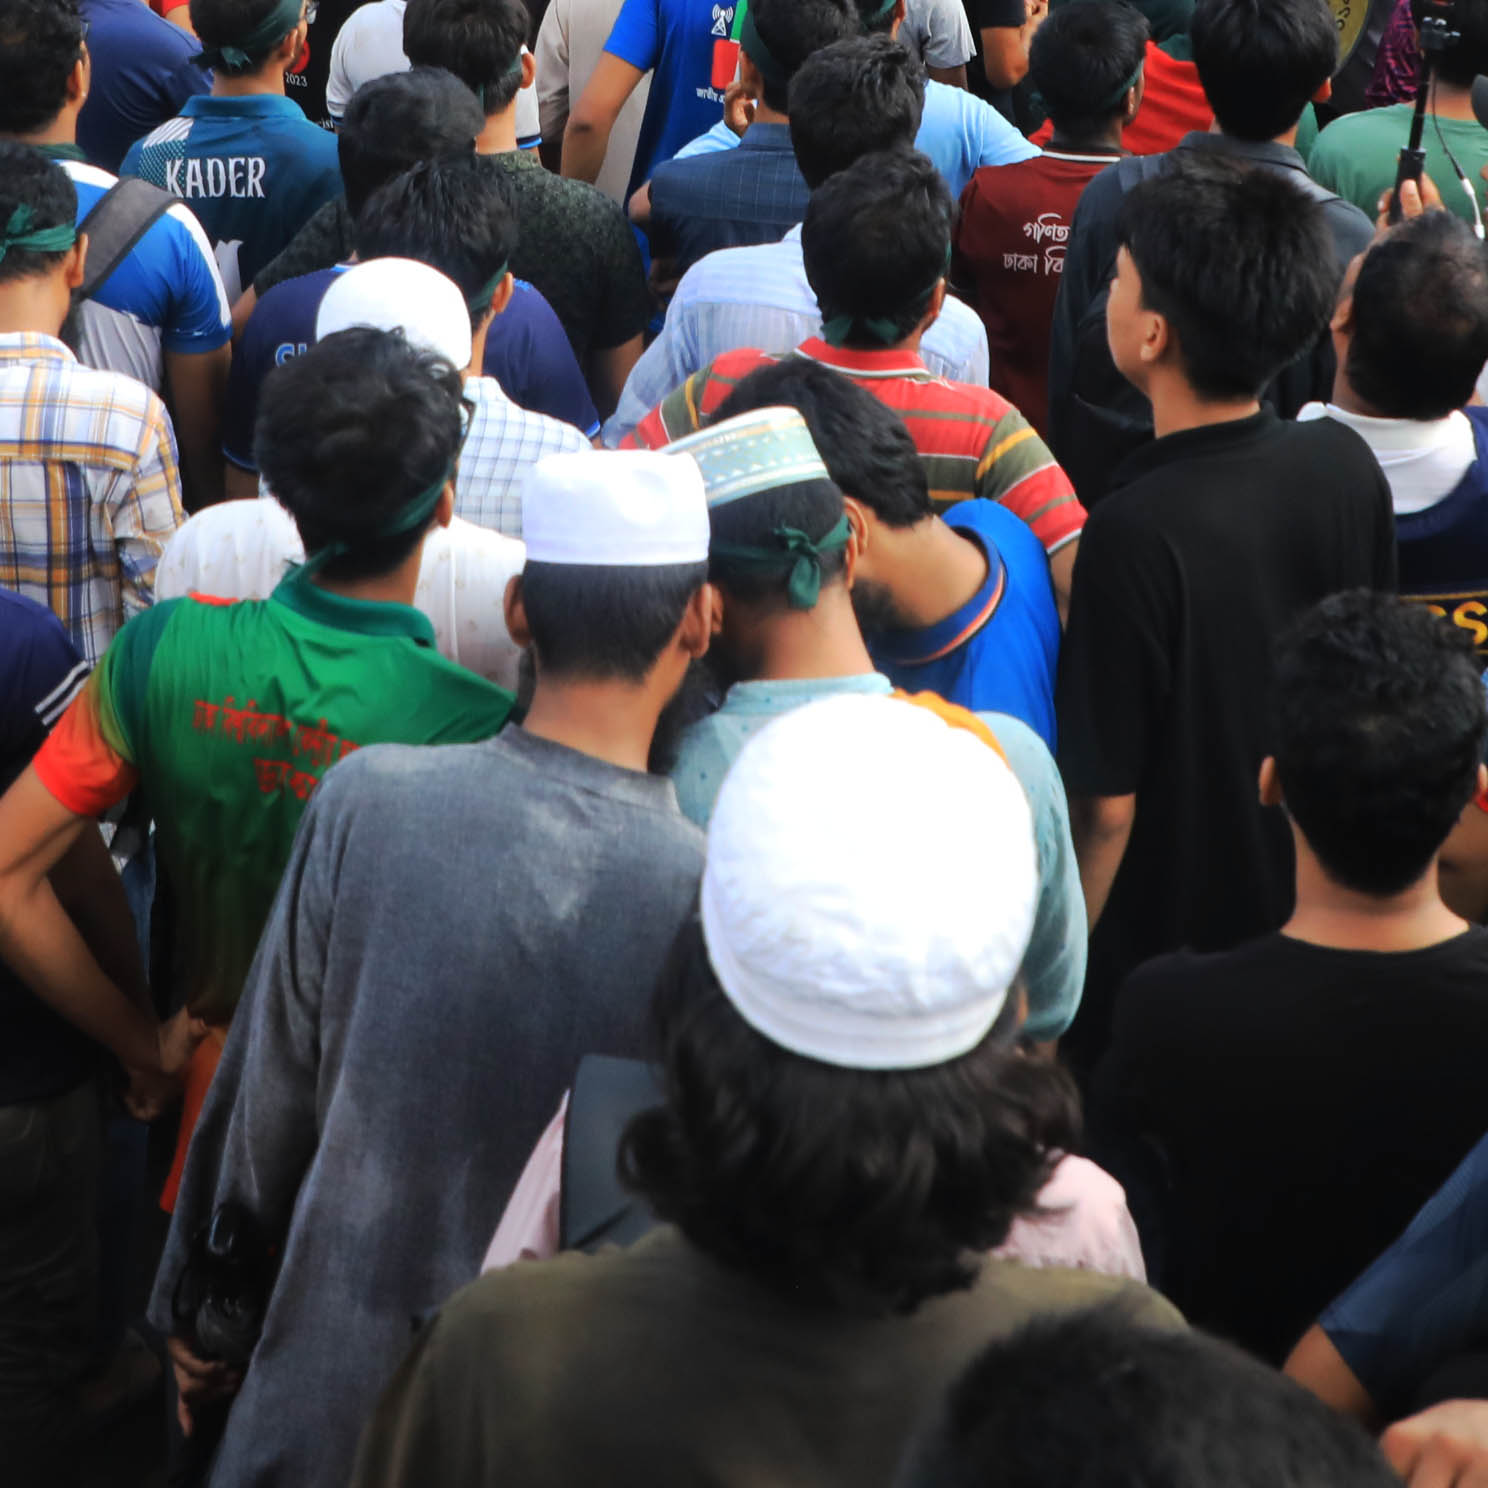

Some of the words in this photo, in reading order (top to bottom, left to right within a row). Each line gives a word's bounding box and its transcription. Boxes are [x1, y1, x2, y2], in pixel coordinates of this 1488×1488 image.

[285, 72, 309, 88] 2023
[165, 157, 267, 199] KADER
[1023, 212, 1071, 244] গণিত
[1002, 253, 1039, 274] ঢাকা
